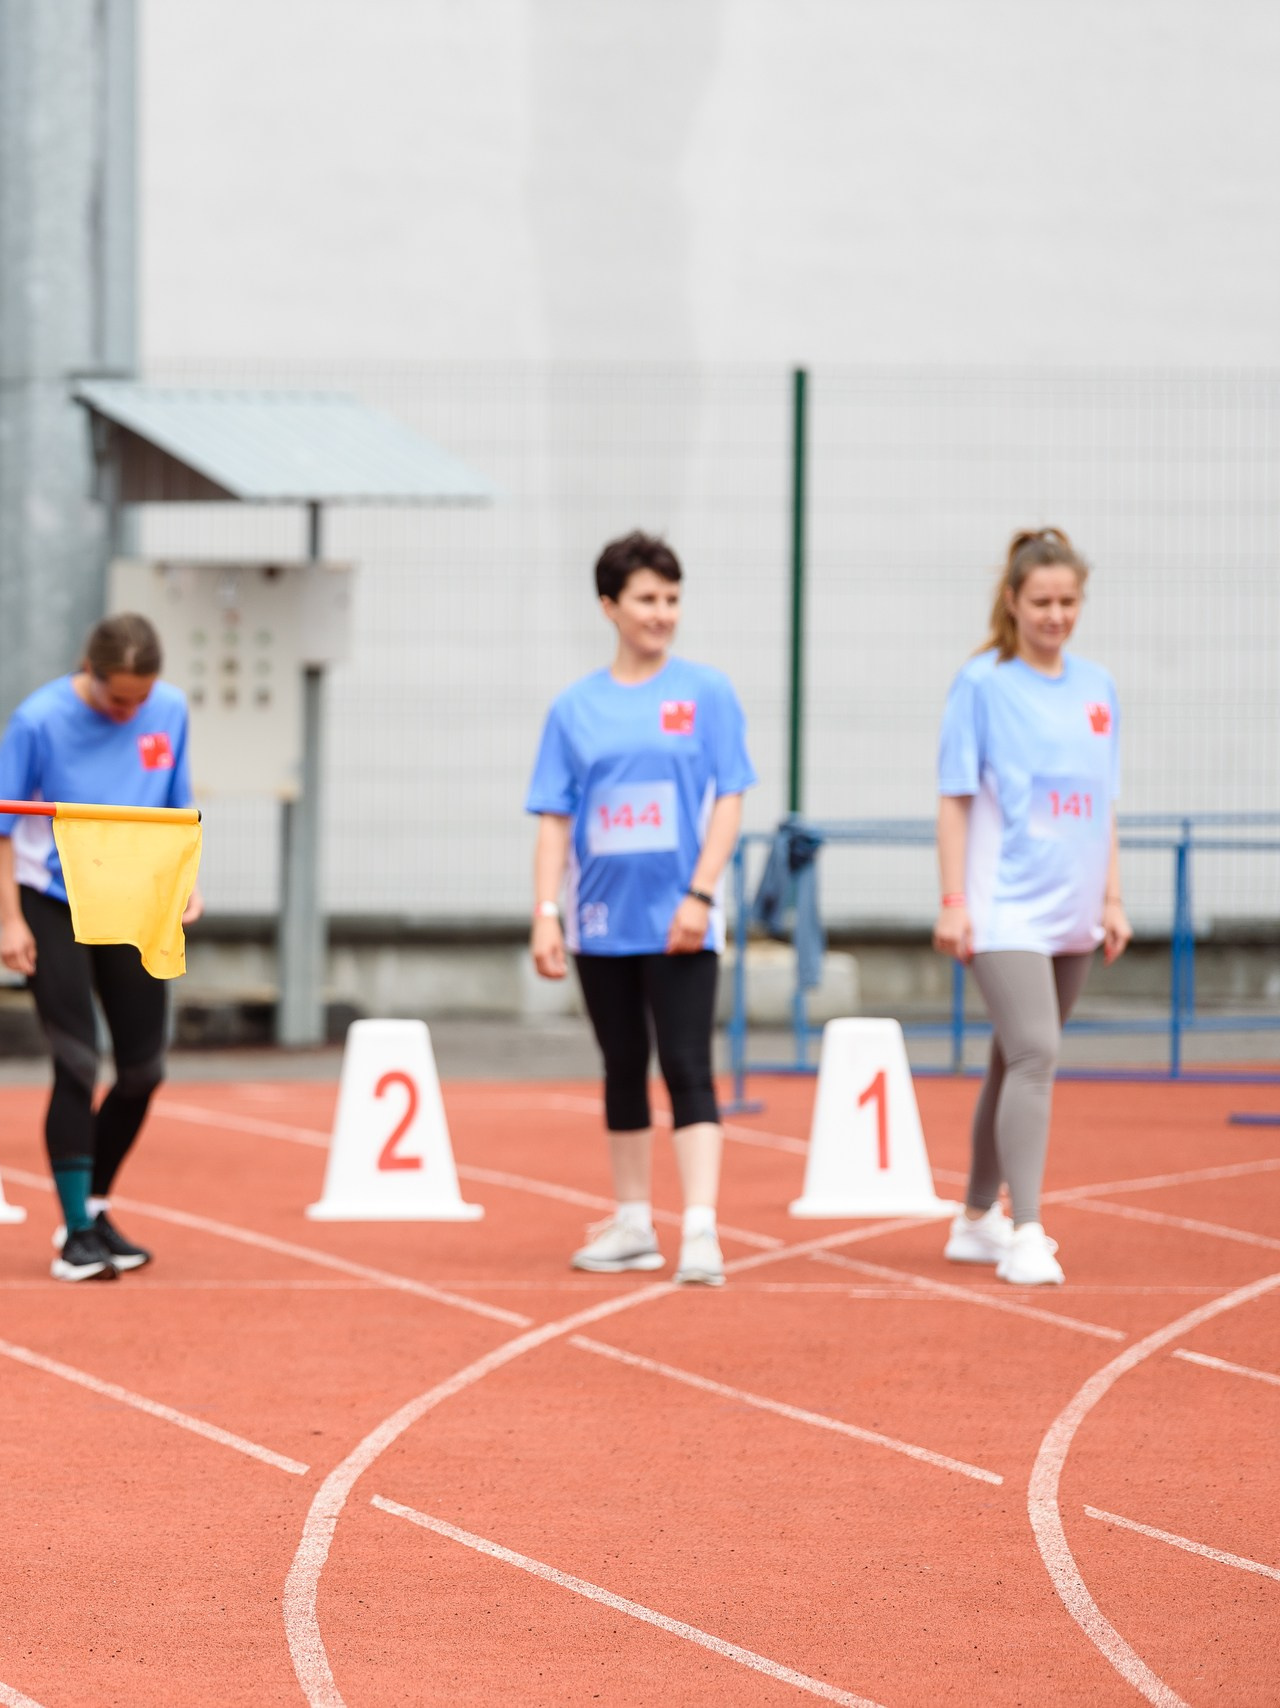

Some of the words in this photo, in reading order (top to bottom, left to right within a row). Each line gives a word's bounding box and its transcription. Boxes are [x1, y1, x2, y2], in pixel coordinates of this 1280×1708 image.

[599, 802, 662, 832] 144
[1049, 790, 1093, 819] 141
[373, 1070, 423, 1172] 2
[857, 1070, 889, 1171] 1
